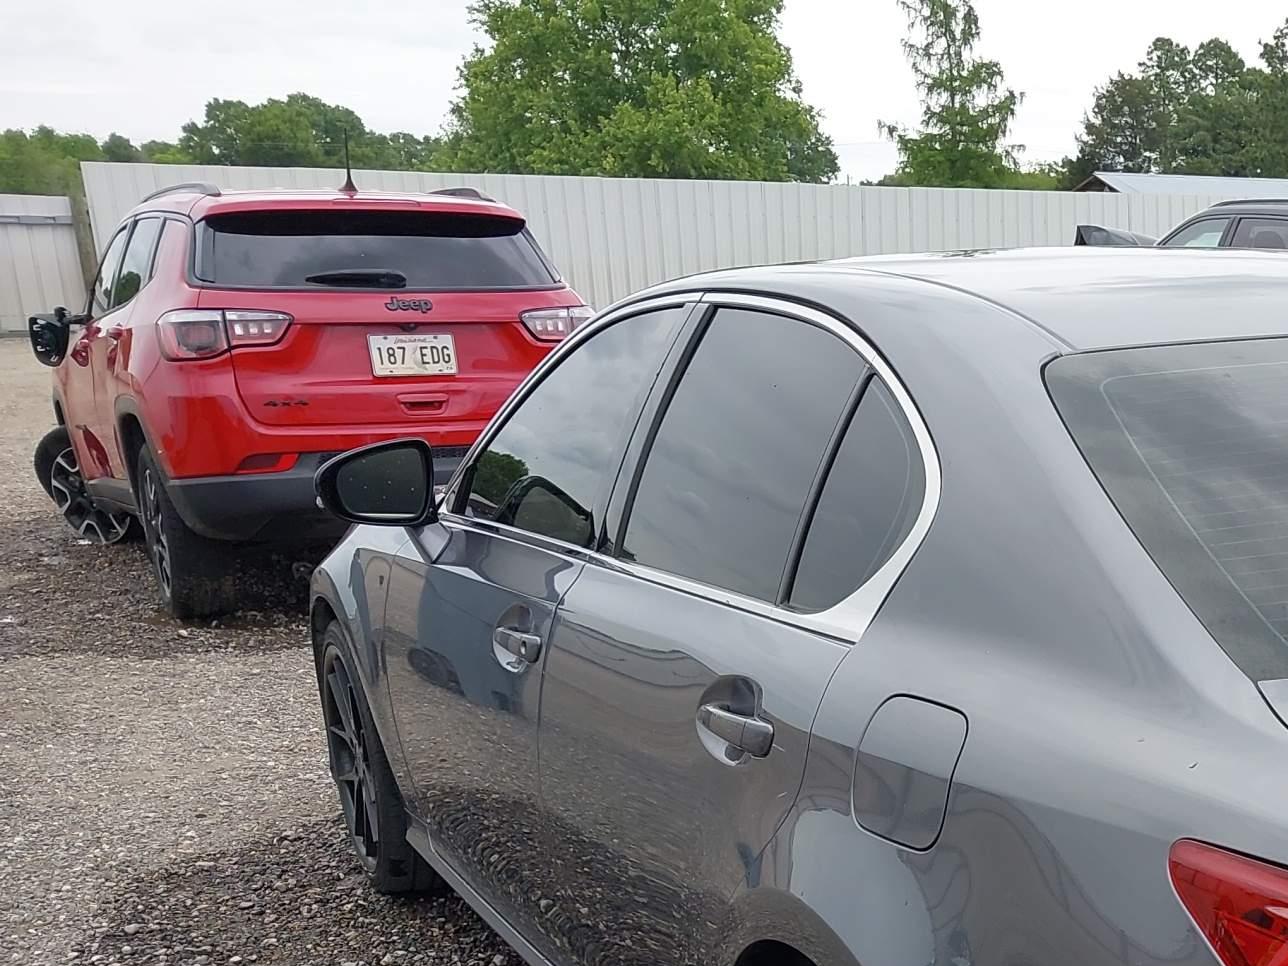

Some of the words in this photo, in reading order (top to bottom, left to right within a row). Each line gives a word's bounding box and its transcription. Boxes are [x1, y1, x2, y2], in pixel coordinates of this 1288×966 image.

[384, 296, 433, 314] Jeep
[376, 346, 407, 366] 187
[420, 345, 452, 365] EDG
